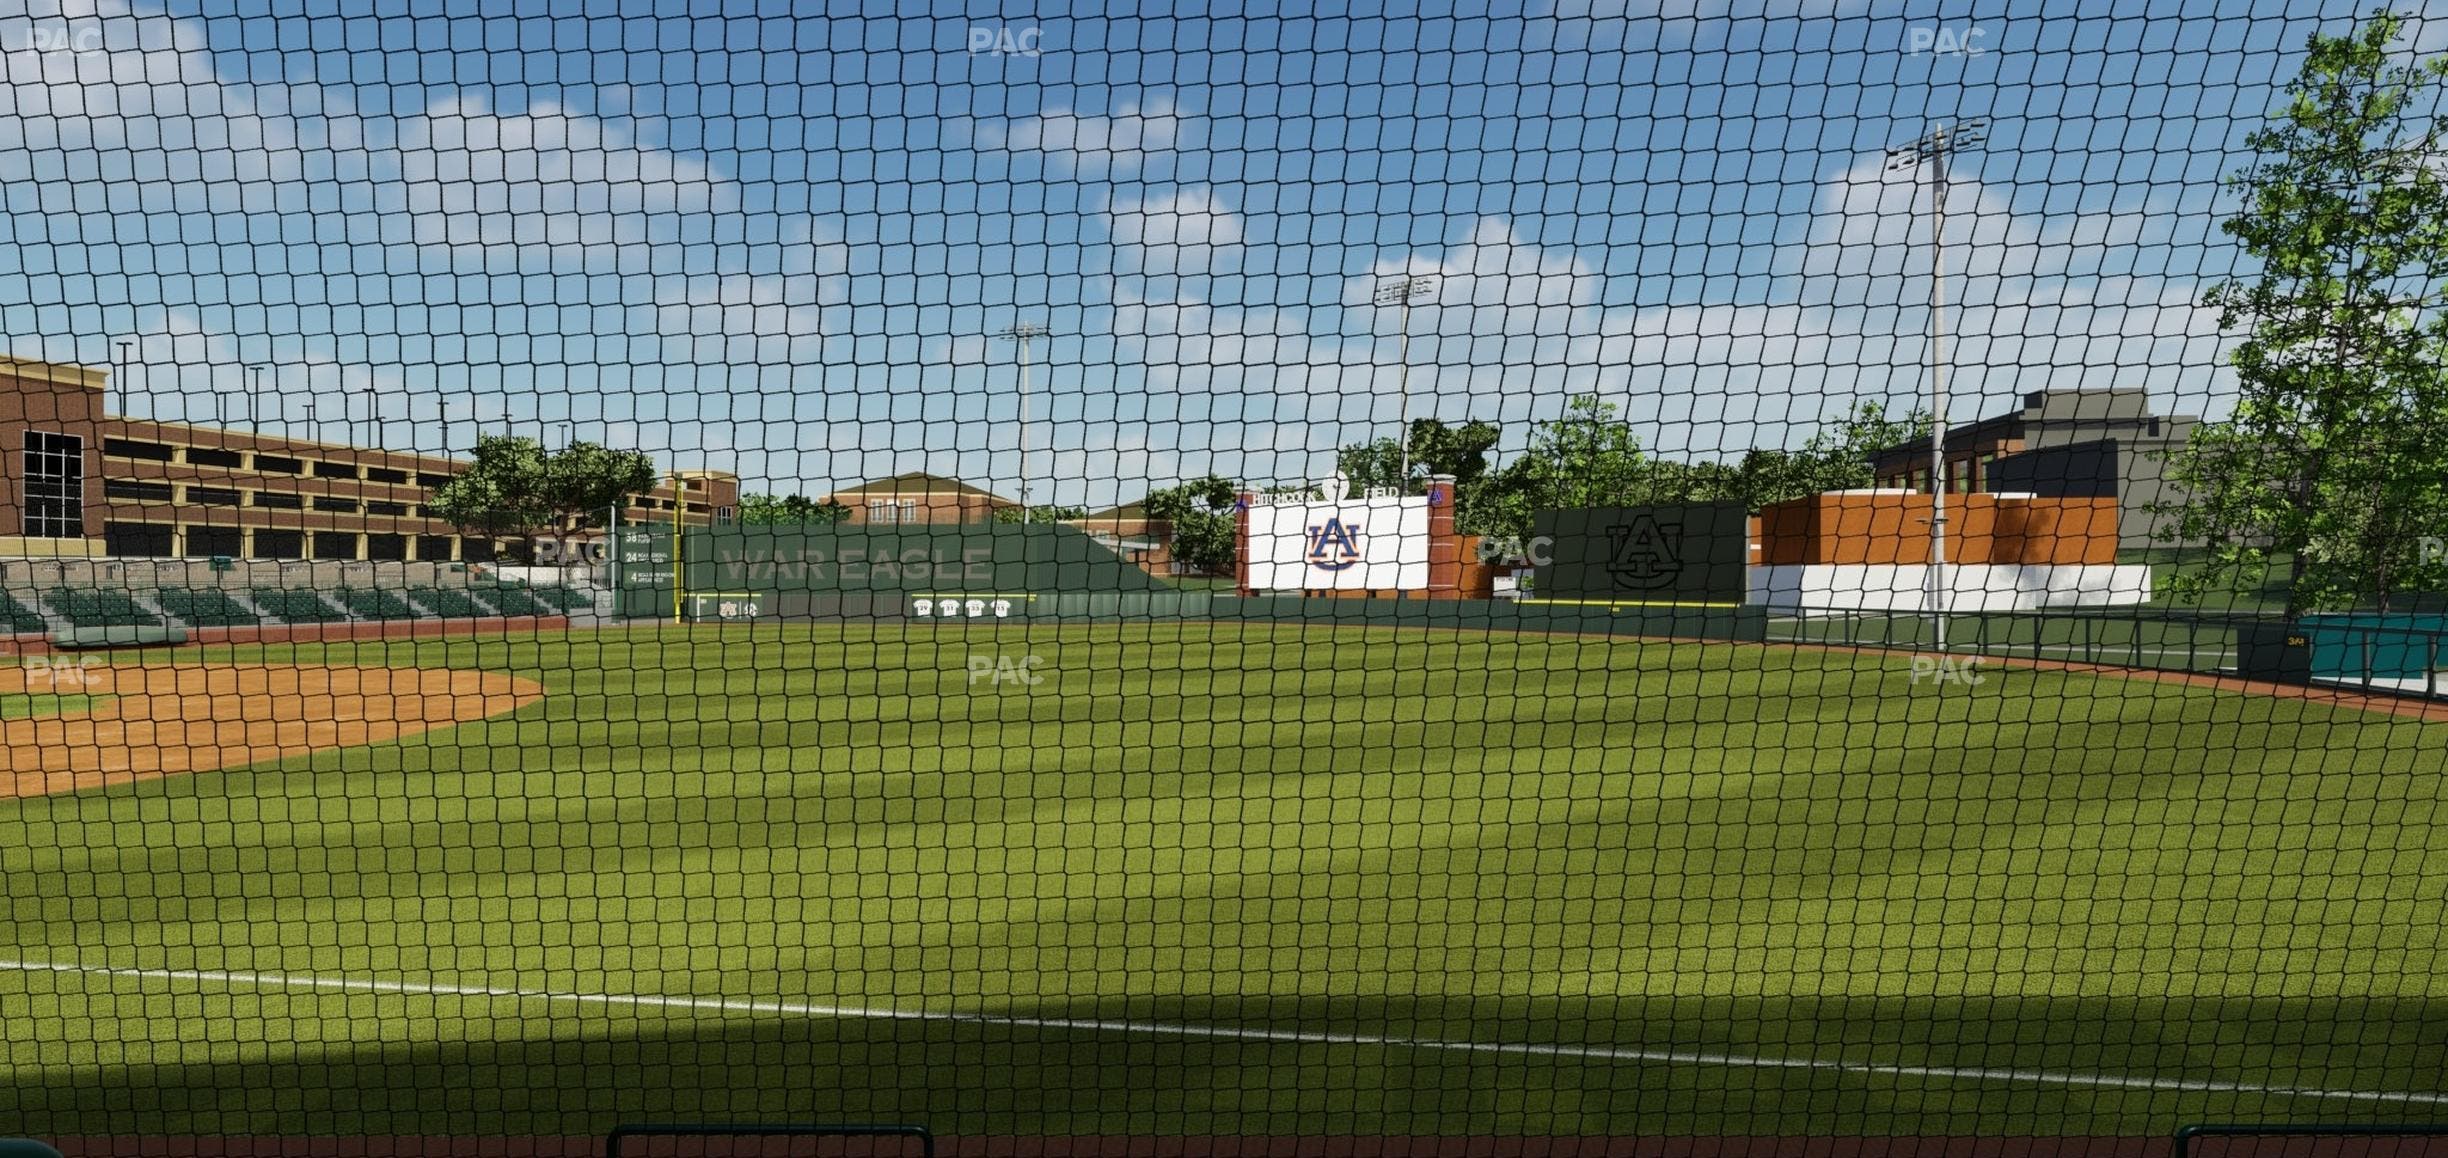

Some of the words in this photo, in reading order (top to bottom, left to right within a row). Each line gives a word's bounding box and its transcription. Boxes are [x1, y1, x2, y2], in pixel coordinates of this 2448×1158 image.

[1253, 490, 1318, 505] HITCHCOCK
[1364, 486, 1399, 499] FIELD
[626, 552, 637, 562] 24
[722, 549, 825, 580] WAR
[838, 548, 992, 580] EAGLE
